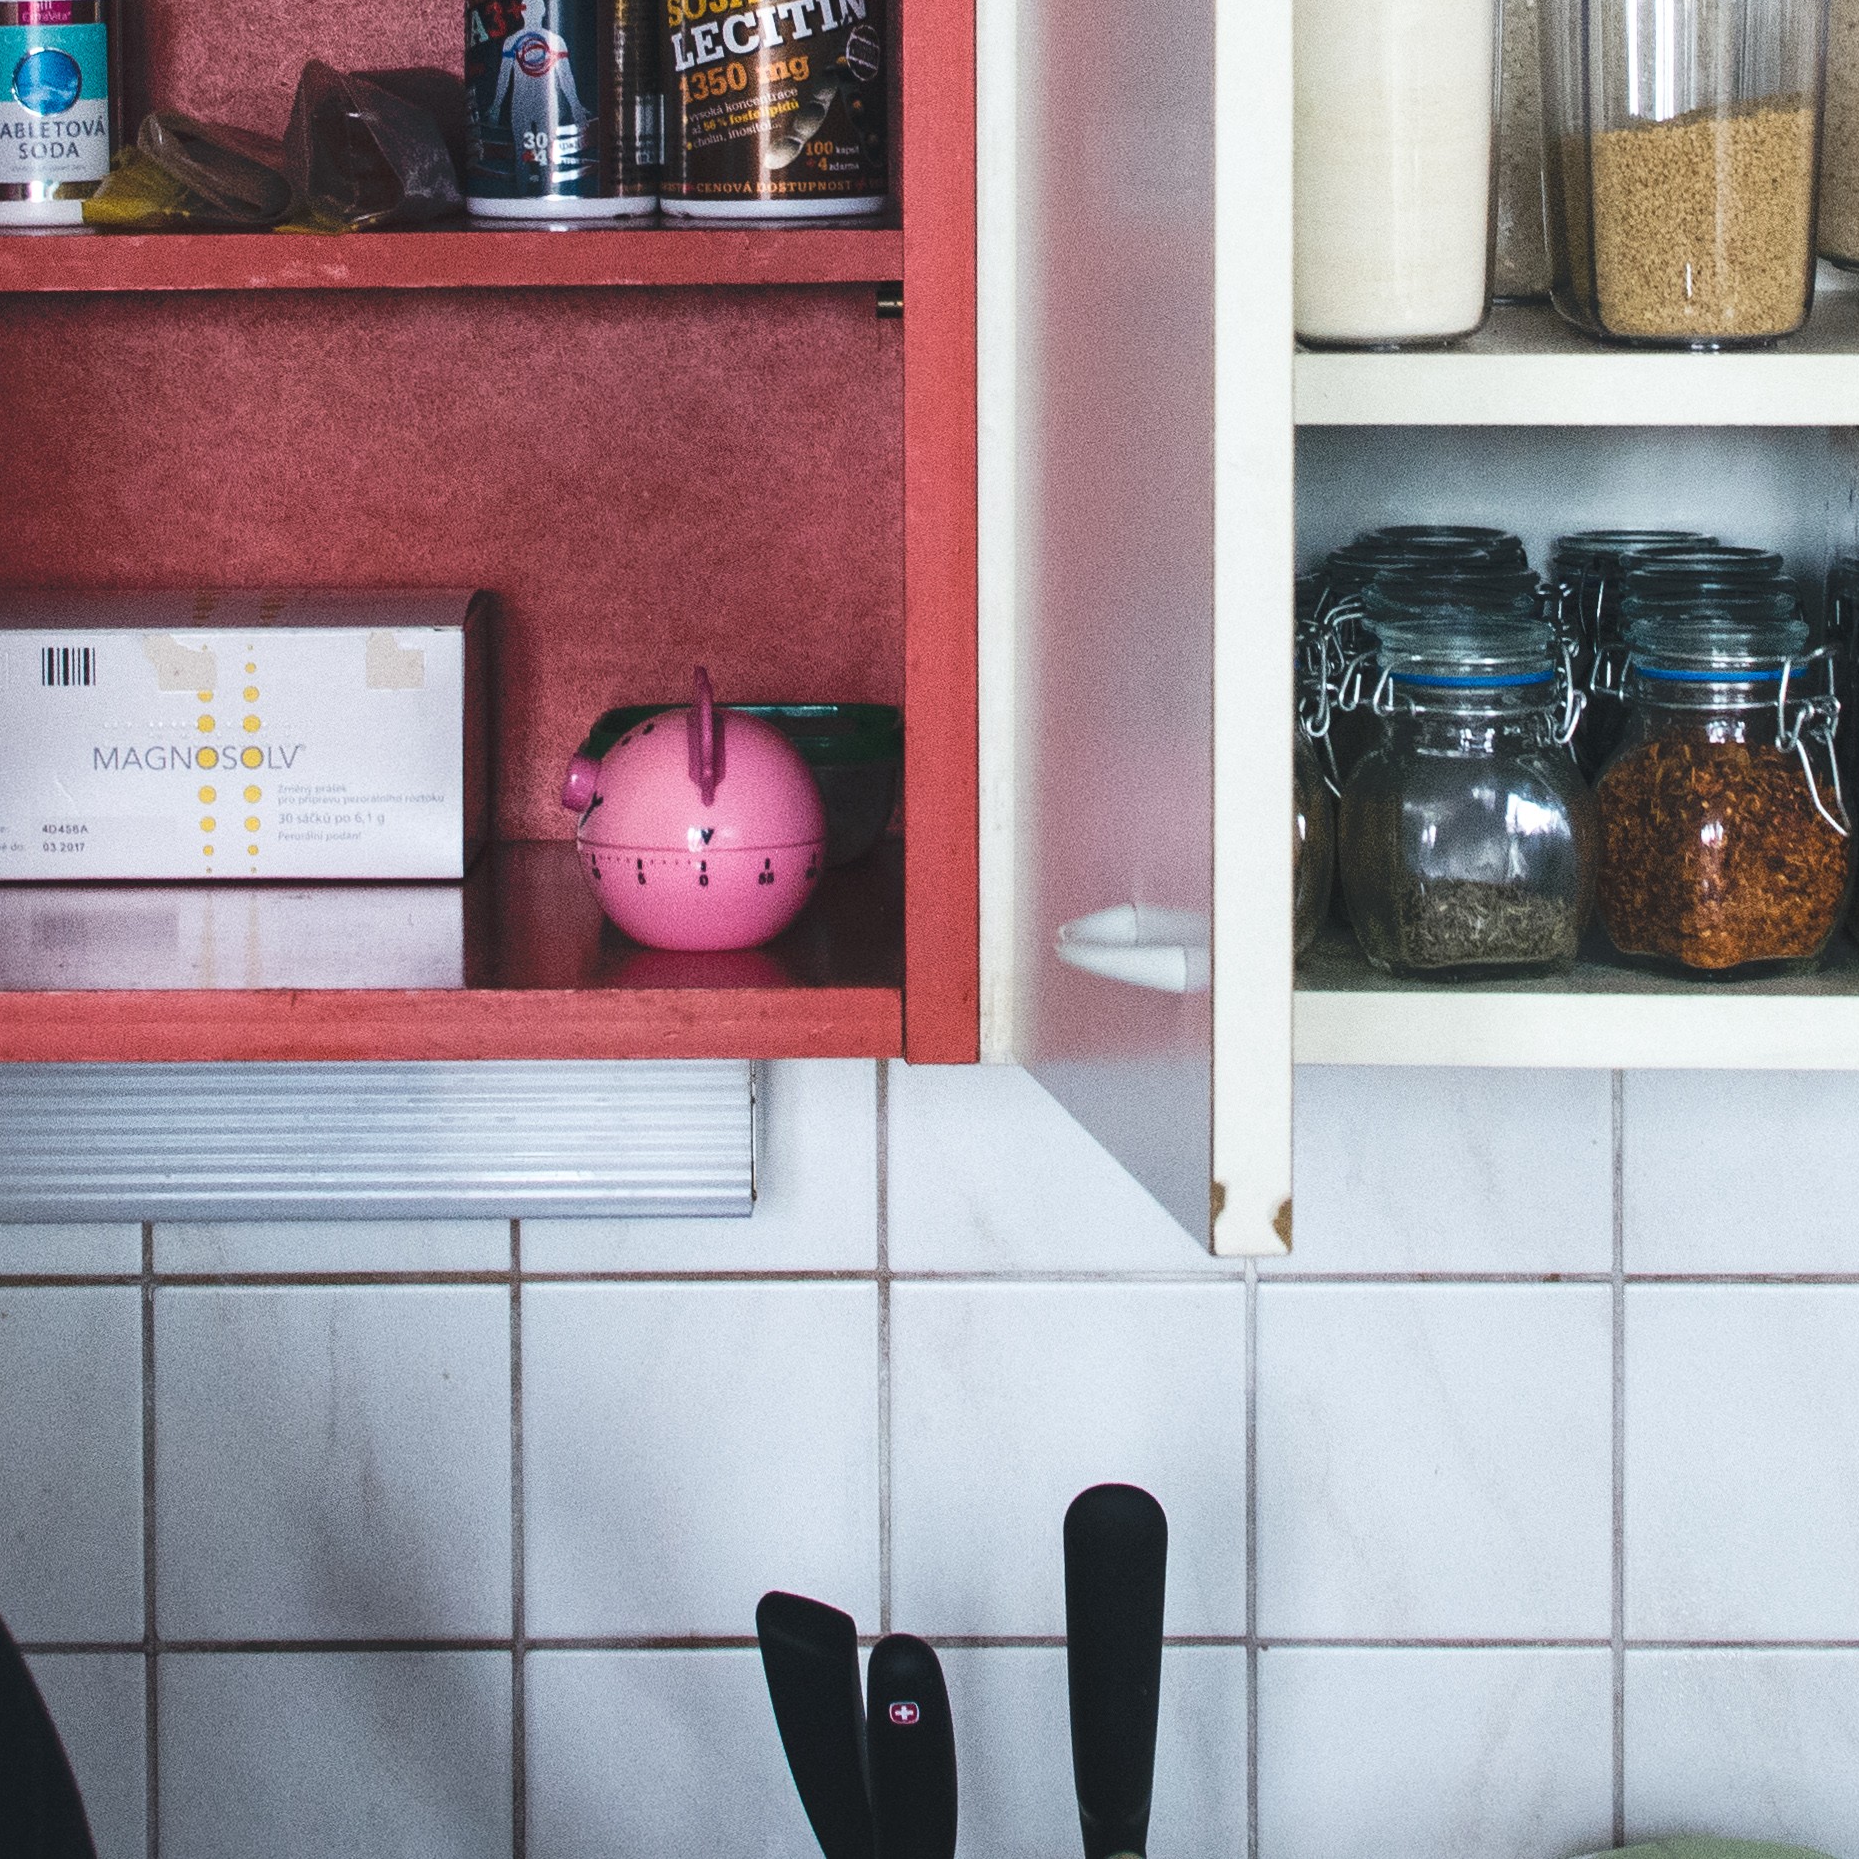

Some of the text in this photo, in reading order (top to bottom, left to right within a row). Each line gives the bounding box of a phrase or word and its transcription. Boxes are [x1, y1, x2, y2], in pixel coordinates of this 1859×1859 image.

[678, 54, 811, 105] 1350 mg
[523, 131, 549, 150] 30
[805, 140, 835, 156] 100
[18, 142, 80, 160] SODA
[696, 180, 753, 194] CENOVÁ
[756, 180, 852, 194] DOSTUPNOST
[277, 813, 294, 824] 30
[334, 815, 351, 826] po
[377, 814, 385, 826] g
